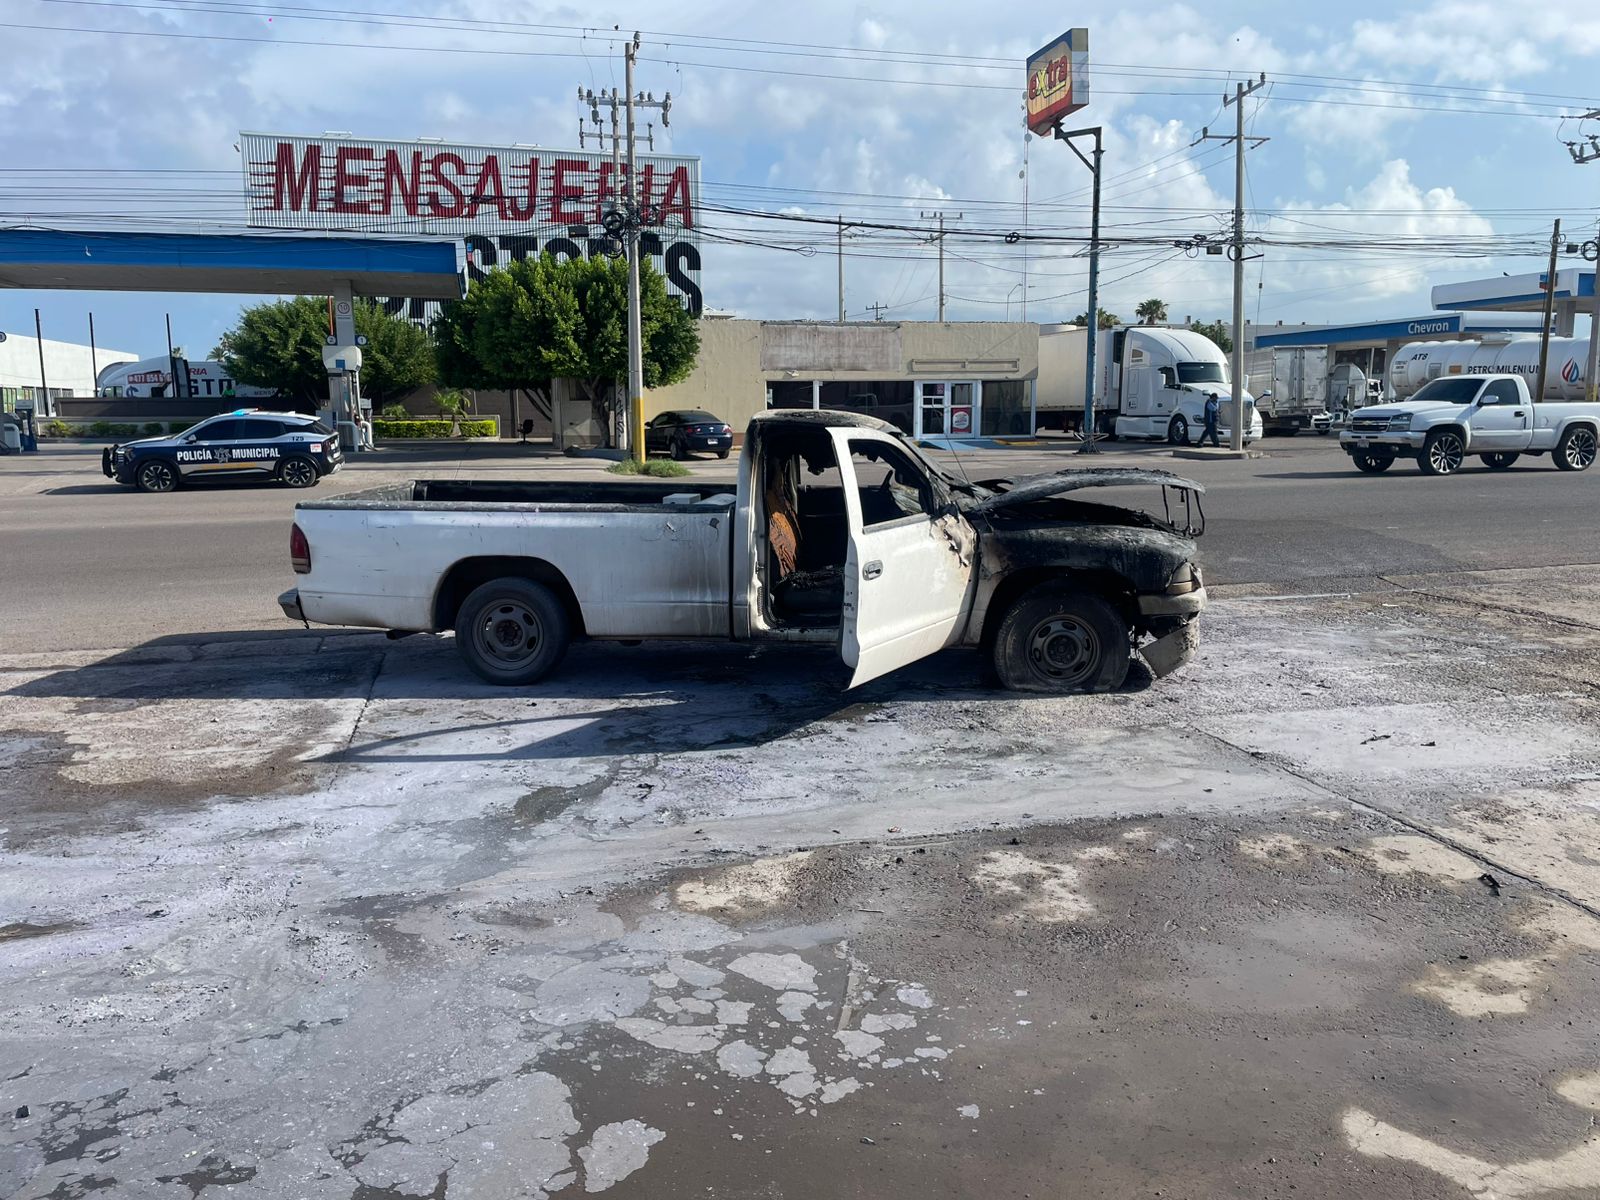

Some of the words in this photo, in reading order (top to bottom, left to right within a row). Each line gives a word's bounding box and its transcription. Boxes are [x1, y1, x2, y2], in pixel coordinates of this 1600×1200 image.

[1028, 55, 1067, 100] extra
[273, 142, 693, 229] MENSAJERIA
[1407, 321, 1449, 335] Chevron
[189, 367, 208, 375] RIA
[176, 448, 212, 461] POLICÍA
[232, 447, 280, 459] MUNICIPAL
